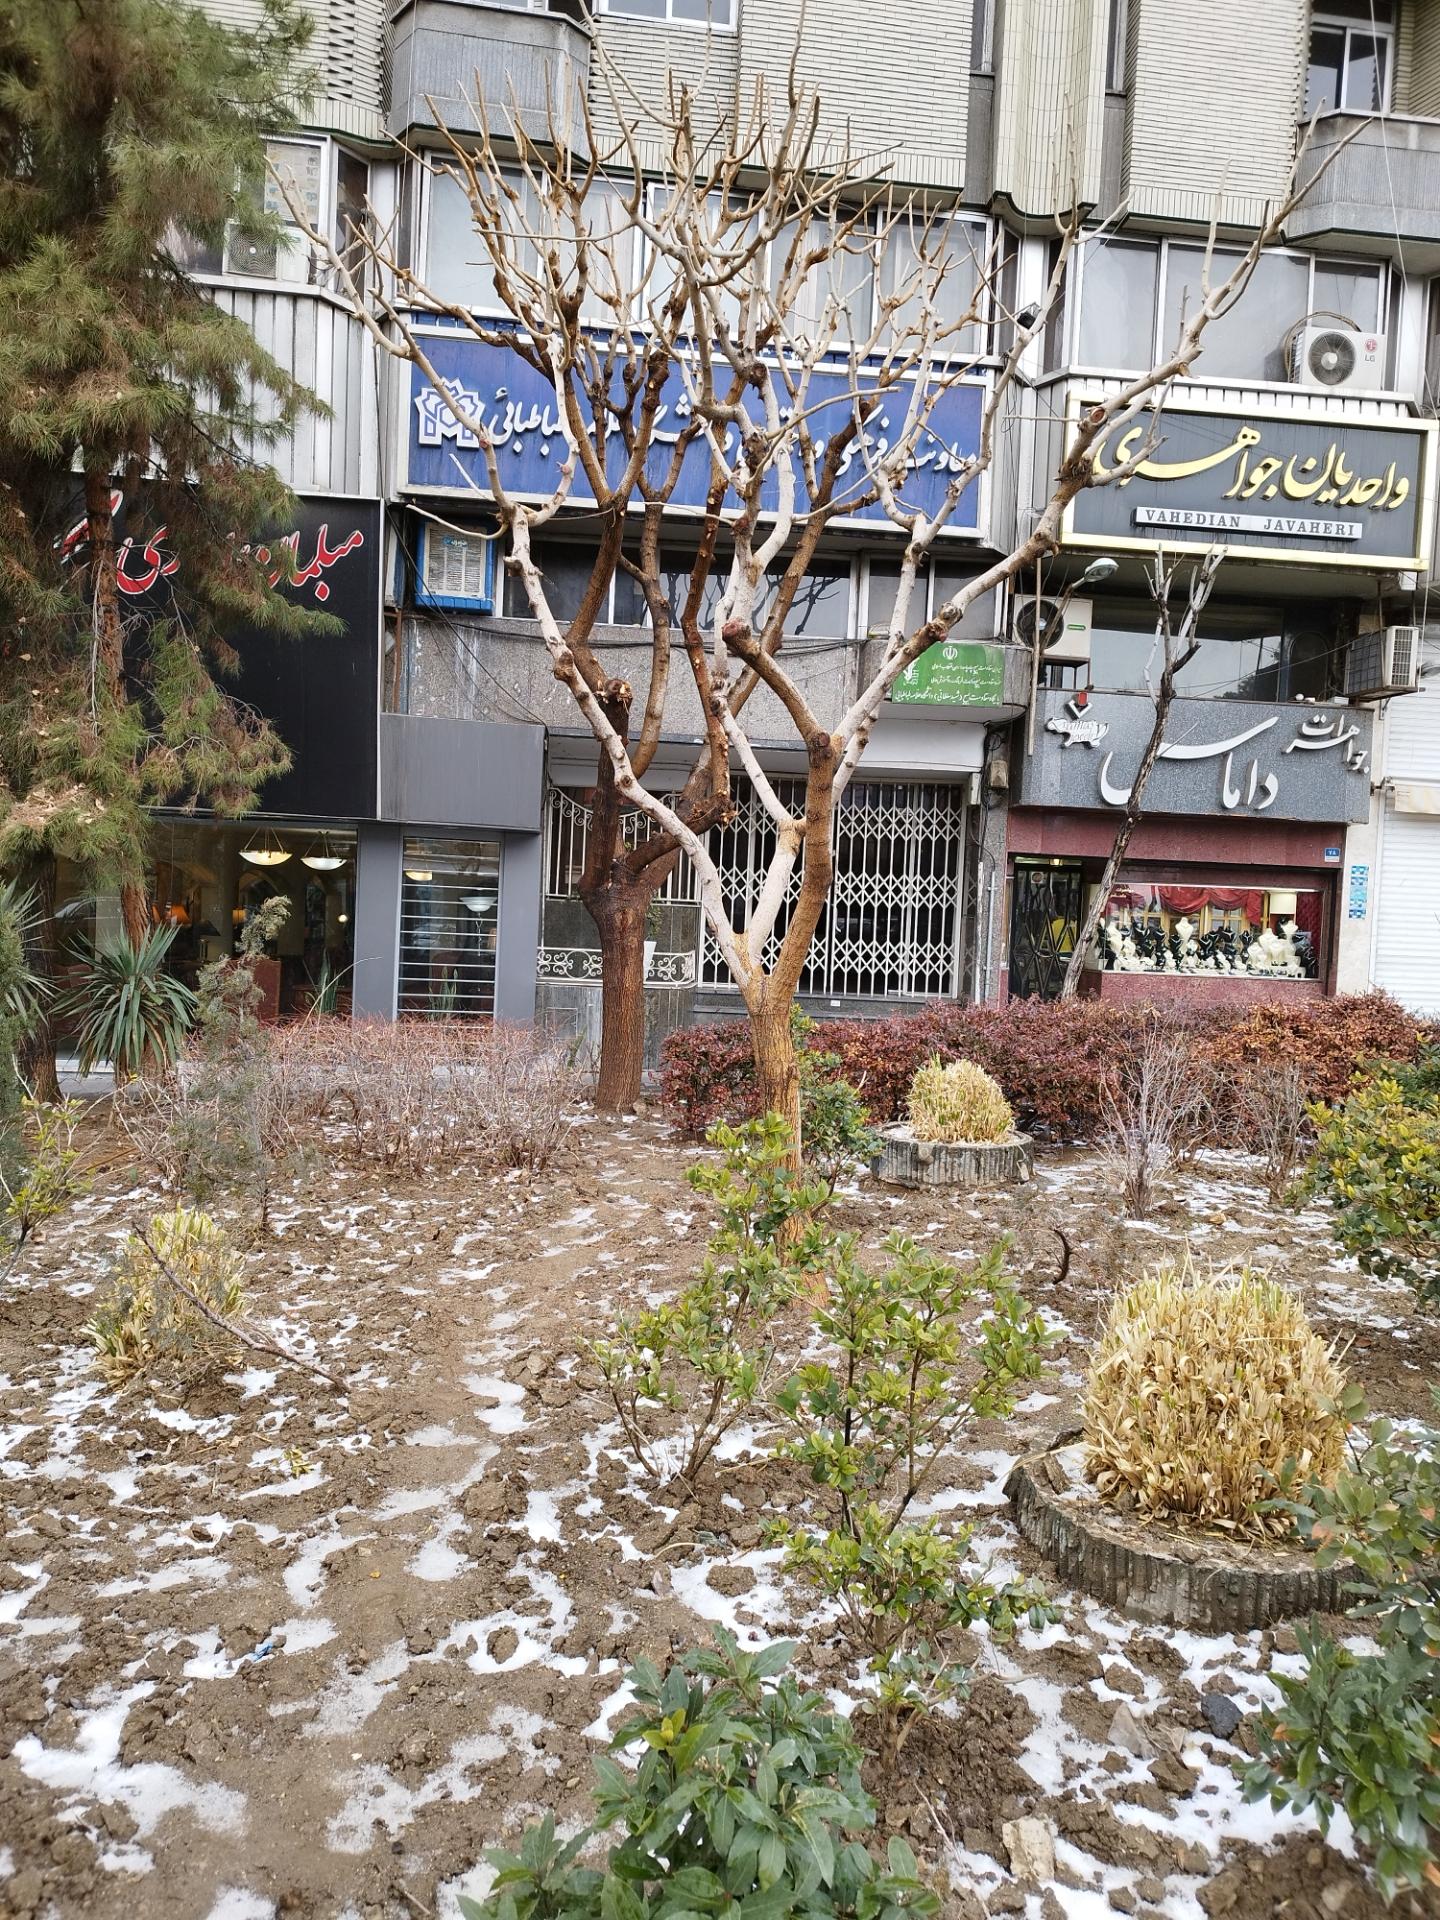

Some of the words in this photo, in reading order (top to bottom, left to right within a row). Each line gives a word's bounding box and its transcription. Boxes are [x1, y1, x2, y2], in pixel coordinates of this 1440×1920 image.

[1364, 354, 1376, 362] LG
[1093, 426, 1283, 500] جواهری
[1283, 442, 1410, 510] واحدیان
[1145, 508, 1240, 529] VAHEDIAN
[1263, 517, 1355, 538] JAVAHERI
[1100, 716, 1280, 810] داماس
[1286, 714, 1370, 774] جواهرات
